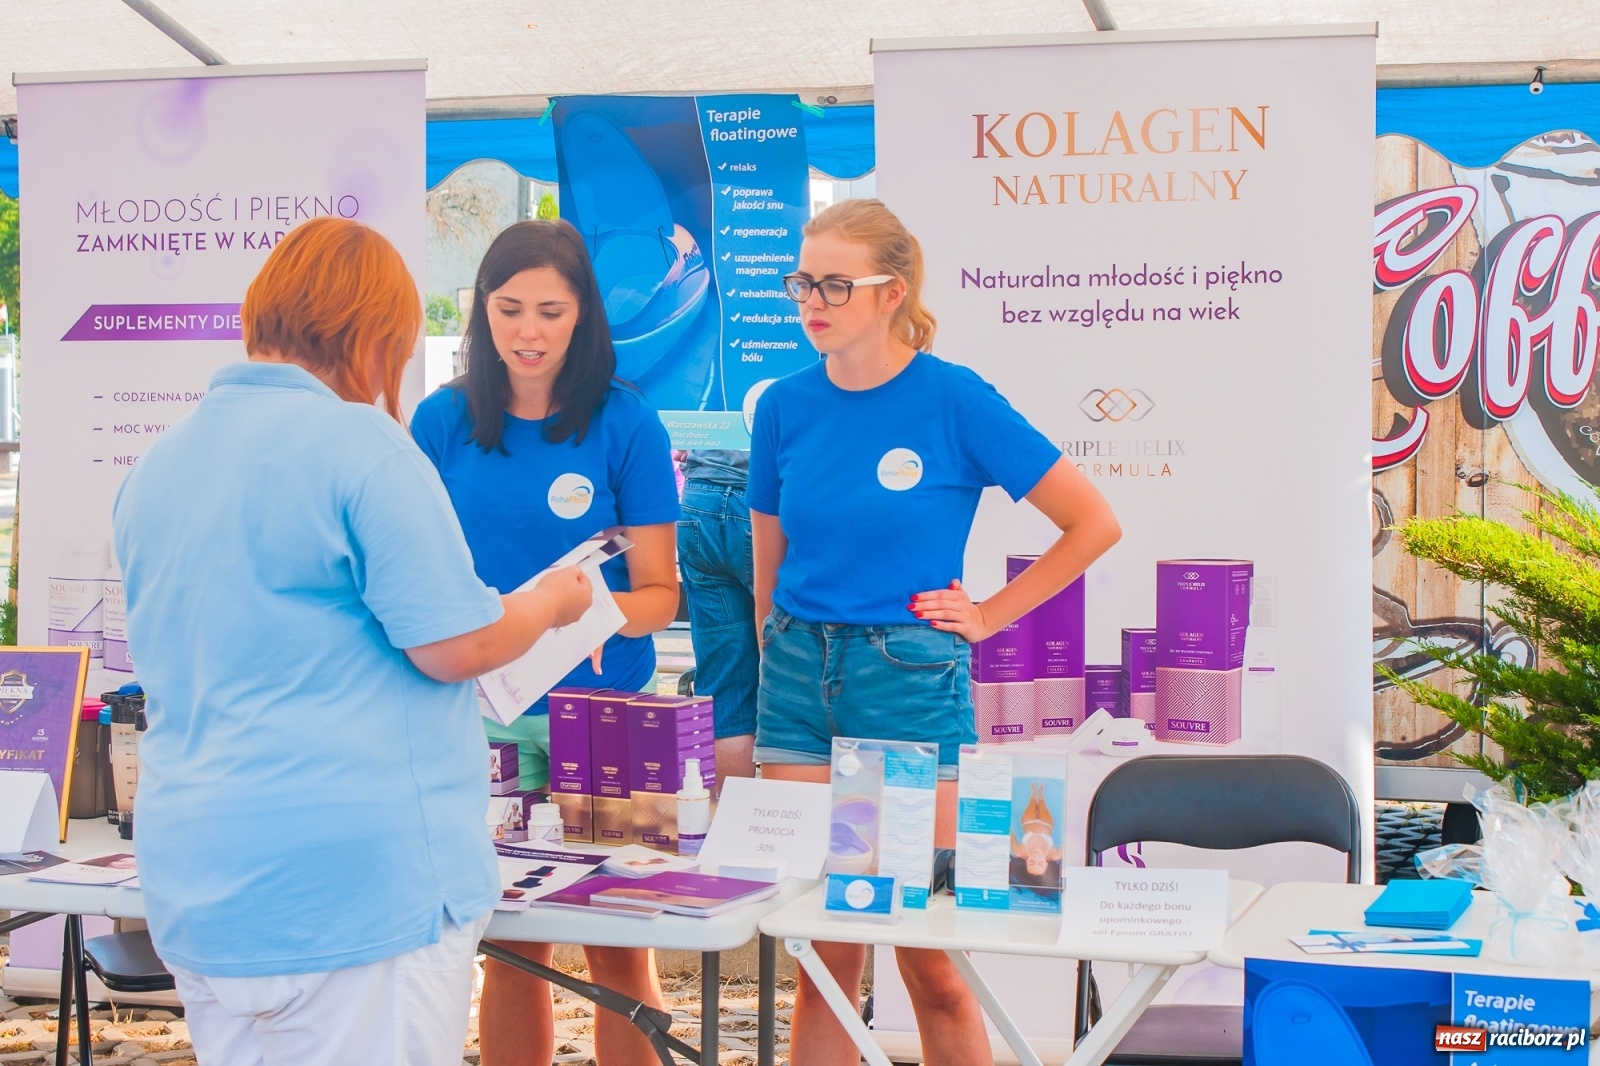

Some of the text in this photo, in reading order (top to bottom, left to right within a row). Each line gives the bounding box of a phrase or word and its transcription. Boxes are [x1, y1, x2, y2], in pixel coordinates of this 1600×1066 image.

[706, 107, 761, 123] Terapie
[710, 127, 798, 142] floatingowe
[972, 105, 1270, 159] KOLAGEN
[730, 162, 757, 171] relaks
[992, 169, 1249, 206] NATURALNY
[732, 189, 774, 198] poprawa
[76, 193, 359, 226] MŁODOŚĆ I PIĘKNO
[732, 200, 784, 212] jakości snu
[733, 228, 788, 239] regeneracja
[76, 232, 206, 256] ZAMKNIĘTE
[215, 231, 235, 250] W
[734, 253, 795, 264] uzupełnienie
[735, 267, 778, 277] magnezu
[961, 260, 1283, 292] Naturalna młodość i piękno
[1001, 297, 1240, 329] bez względu na wiek
[94, 314, 242, 331] SUPLEMENTY DIE
[742, 314, 782, 325] redukcja
[741, 340, 798, 350] uśmierzenie
[741, 353, 763, 362] bólu
[113, 392, 182, 402] CODZIENNA
[113, 424, 140, 434] MOC
[667, 420, 731, 430] Warszawska 22
[1127, 440, 1187, 457] HELIX
[1076, 462, 1172, 477] ORMULA
[1044, 719, 1071, 727] SOUVRE
[1171, 720, 1207, 732] SOUVRE
[993, 726, 1021, 734] SOUVRE
[754, 808, 779, 818] TYLKO
[1115, 880, 1179, 892] TYLKO DZIŚ!
[1100, 901, 1192, 912] Do każdego bonu
[1099, 917, 1182, 926] upominkowego
[1110, 929, 1146, 937] Epsom
[1464, 990, 1536, 1013] Terapie
